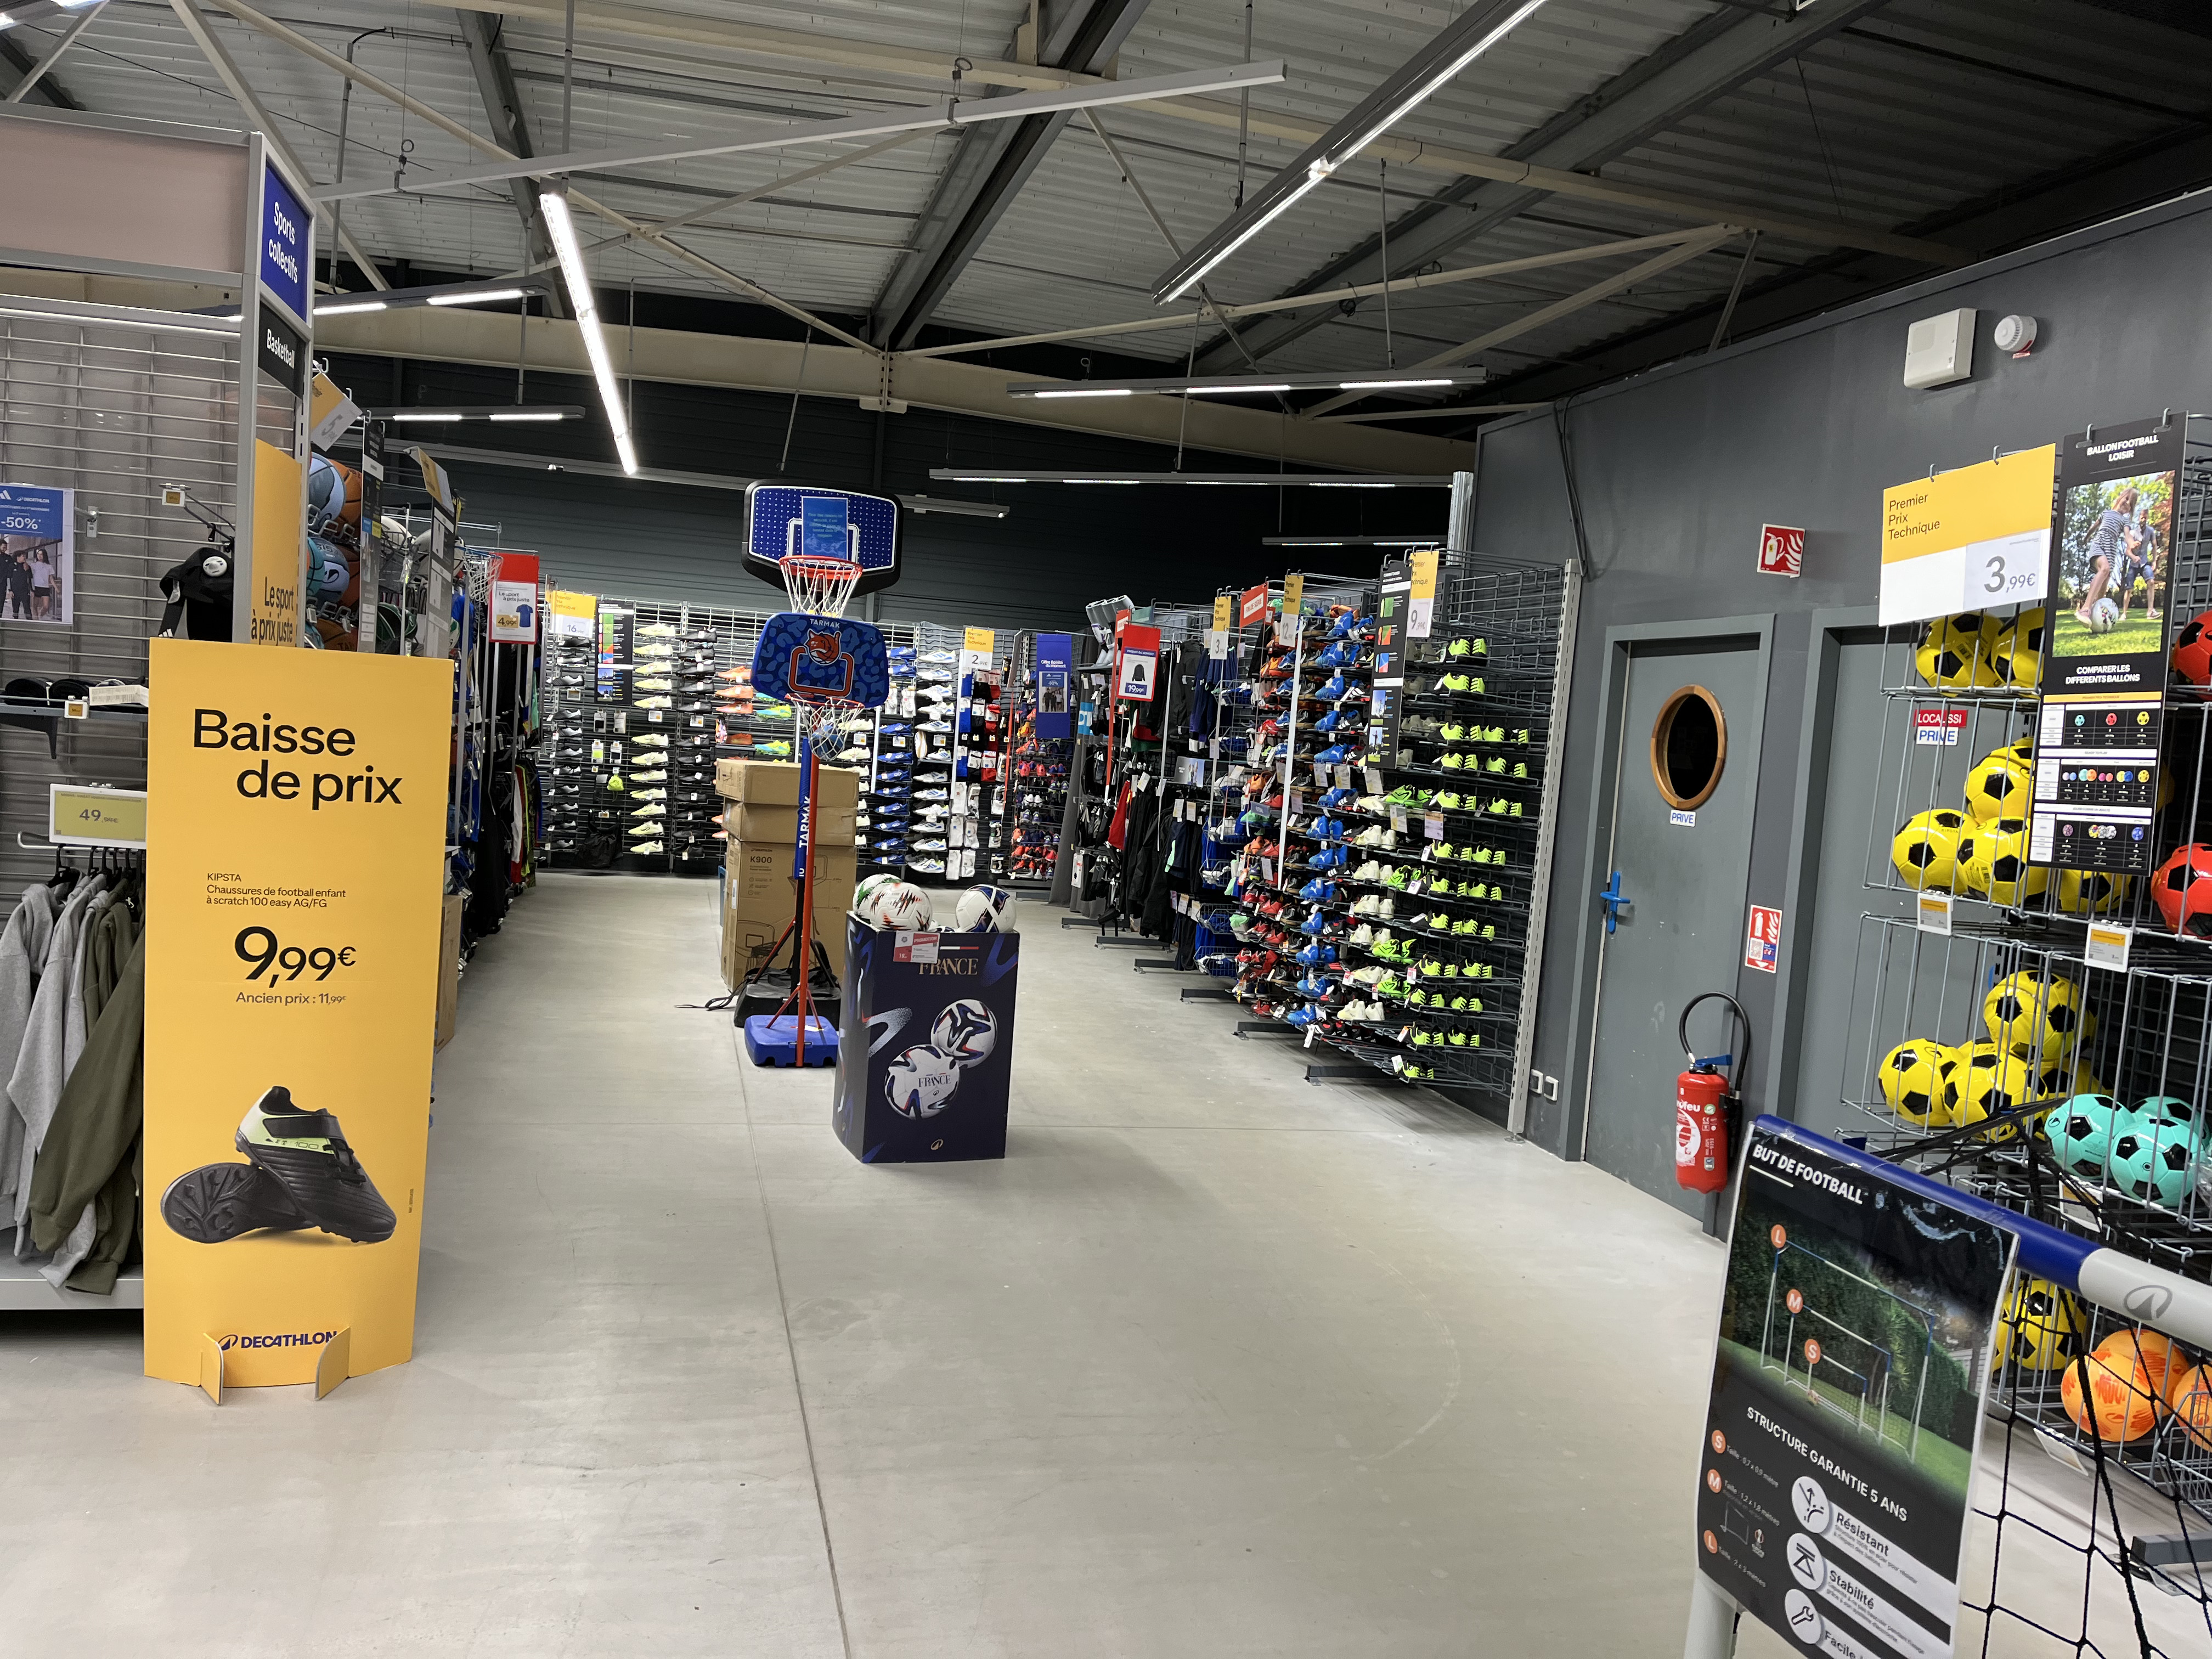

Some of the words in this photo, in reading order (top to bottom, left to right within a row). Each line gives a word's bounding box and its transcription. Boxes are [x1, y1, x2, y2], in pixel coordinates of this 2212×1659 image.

[274, 201, 295, 245] Sports
[267, 328, 295, 369] Basketball
[2087, 442, 2118, 456] BALLON
[2118, 435, 2159, 449] FOOTBALL
[2108, 449, 2135, 462] LOISIR
[1889, 493, 1929, 512] Premier
[1888, 512, 1908, 526] Prix
[1888, 520, 1940, 540] Technique
[1412, 577, 1429, 586] echnique
[1984, 556, 2036, 593] 3,99€
[264, 576, 275, 607] Le
[276, 585, 294, 616] sport
[251, 608, 257, 640] à
[259, 611, 275, 645] prix
[276, 613, 293, 646] juste
[809, 618, 840, 629] TARMAK
[2076, 665, 2117, 675] COMPARER
[2117, 664, 2131, 673] LES
[2066, 674, 2107, 685] DIFFERENTS
[2107, 673, 2141, 682] BALLONS
[1948, 714, 1962, 724] SSI
[193, 708, 356, 757] Baisse
[236, 759, 300, 800] de
[312, 765, 403, 810] prix
[799, 795, 810, 848] TARMAK
[1672, 812, 1694, 825] PRIVE
[750, 856, 772, 864] K900
[207, 873, 242, 882] KIPSTA
[206, 884, 262, 895] Chaussures
[263, 887, 276, 896] de
[278, 887, 314, 897] football
[315, 888, 346, 898] enfant
[206, 895, 212, 905] à
[213, 896, 249, 906] scratch
[250, 897, 268, 906] 100
[269, 900, 292, 909] easy
[293, 899, 327, 909] AG/FG
[234, 926, 357, 989] 9,99€
[918, 958, 979, 975] FRANCE
[236, 991, 283, 1004] Ancien
[285, 993, 310, 1006] prix
[319, 993, 347, 1006] 11,99€
[918, 1075, 952, 1087] FRANCE
[1753, 1144, 1780, 1165] BUT
[1777, 1154, 1797, 1173] DE
[1795, 1162, 1863, 1205] FOOTBALL
[1774, 1229, 1782, 1244] L
[1787, 1293, 1802, 1311] M
[241, 1330, 337, 1348] DECATHLON
[1808, 1344, 1818, 1360] S
[1715, 1435, 1723, 1449] S
[1747, 1406, 1808, 1457] STRUCTURE
[1809, 1449, 1869, 1497] GARANTIE
[1870, 1488, 1878, 1503] 5
[1880, 1497, 1908, 1522] ANS
[1708, 1472, 1720, 1489] M
[1708, 1535, 1716, 1550] L
[1836, 1513, 1889, 1557] Résistant
[1829, 1570, 1875, 1610] Stabilité
[1825, 1630, 1856, 1659] Facile
